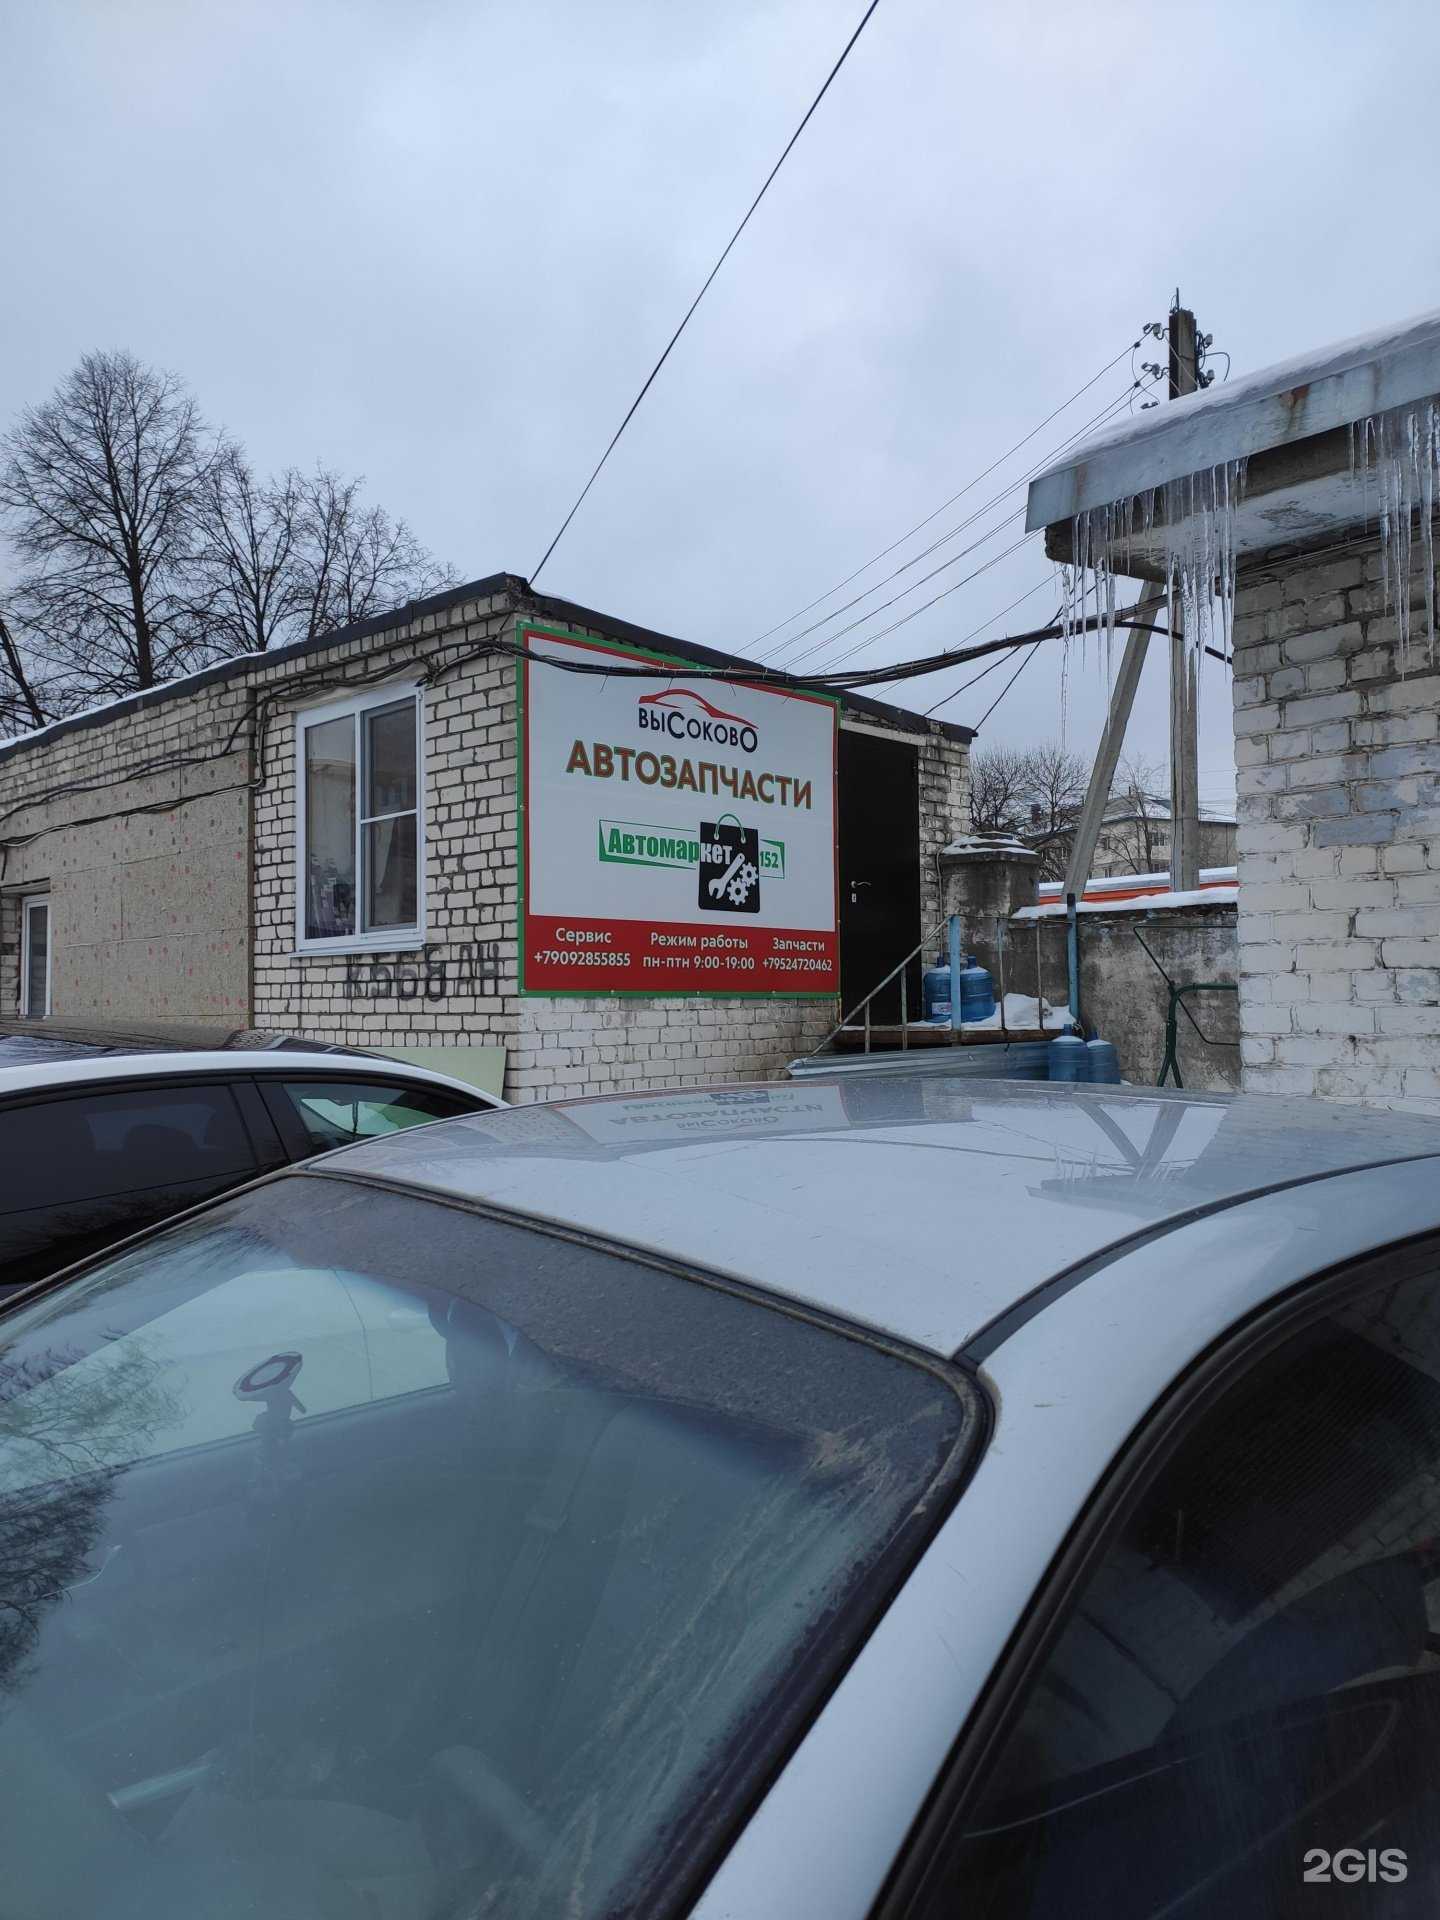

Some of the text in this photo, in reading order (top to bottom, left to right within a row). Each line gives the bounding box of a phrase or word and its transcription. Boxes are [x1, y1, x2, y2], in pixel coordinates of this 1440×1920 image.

[566, 739, 812, 810] АВТОЗАПЧАСТИ
[608, 828, 779, 869] Автомаркет 152
[555, 927, 612, 945] Сервис
[650, 931, 749, 949] Режим работы
[772, 937, 825, 951] Запчасти
[534, 950, 631, 967] +79092855855
[693, 955, 755, 969] 9:00-19:00
[762, 957, 833, 972] +79524720462
